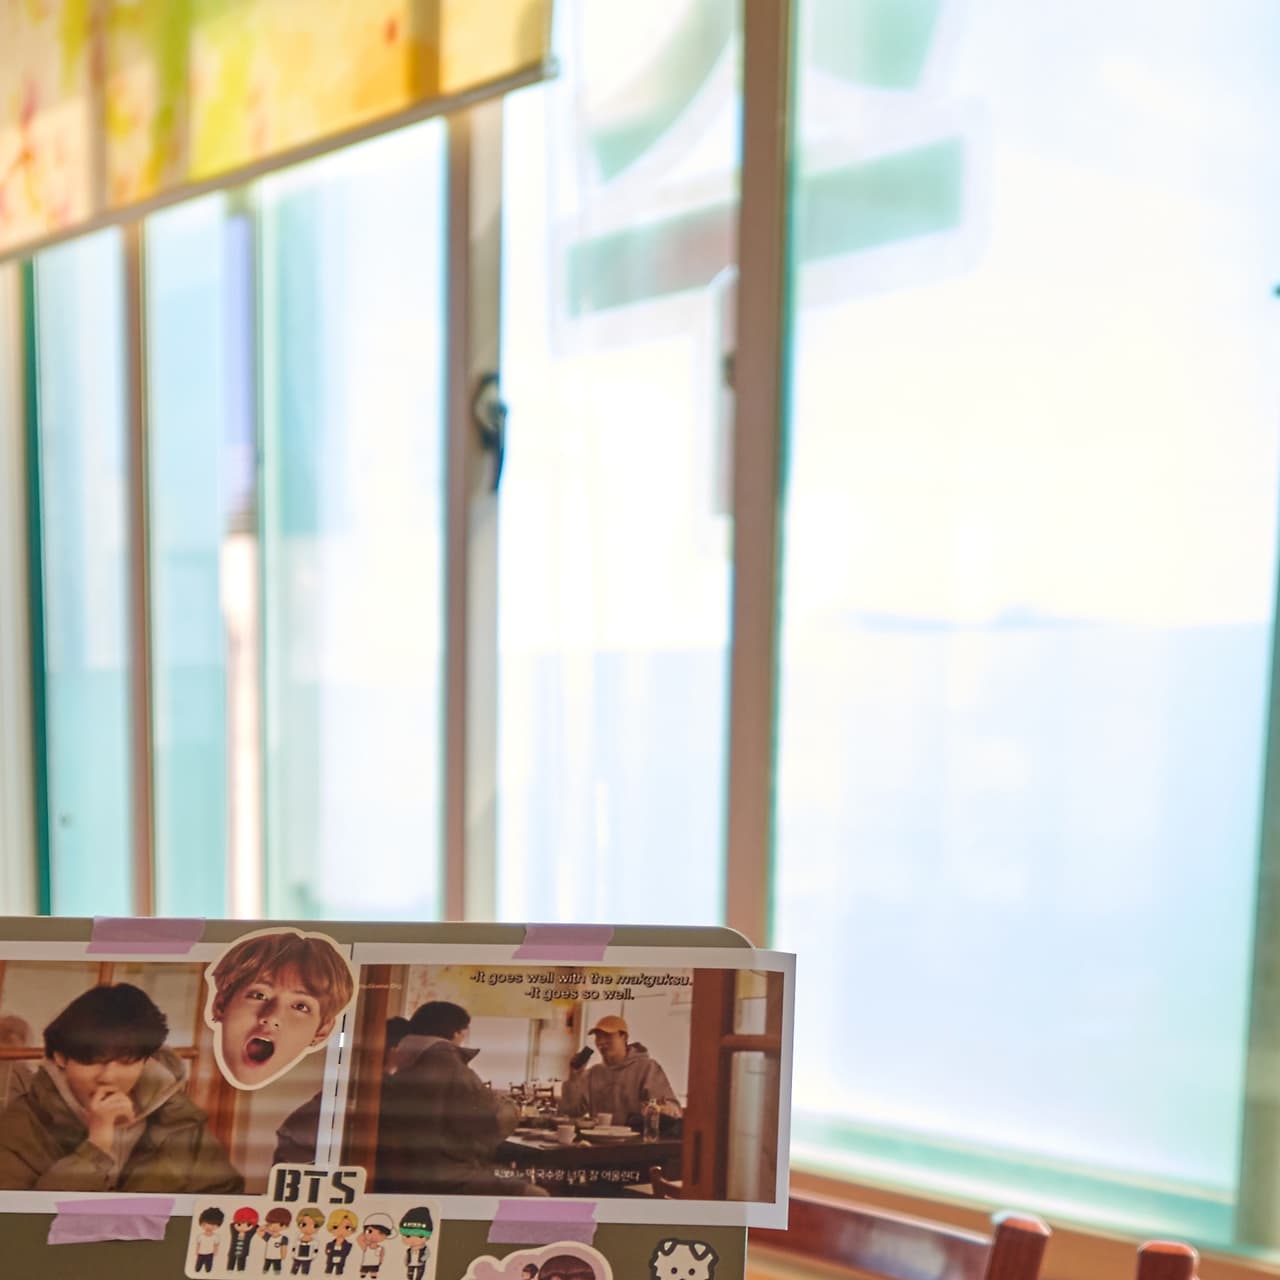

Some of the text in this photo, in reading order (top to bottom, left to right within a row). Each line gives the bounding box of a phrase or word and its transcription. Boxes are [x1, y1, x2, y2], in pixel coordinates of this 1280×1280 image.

[470, 971, 693, 988] -It goes well with the makguksu.
[525, 987, 635, 1002] -It goes so well.
[273, 1169, 357, 1204] BTS
